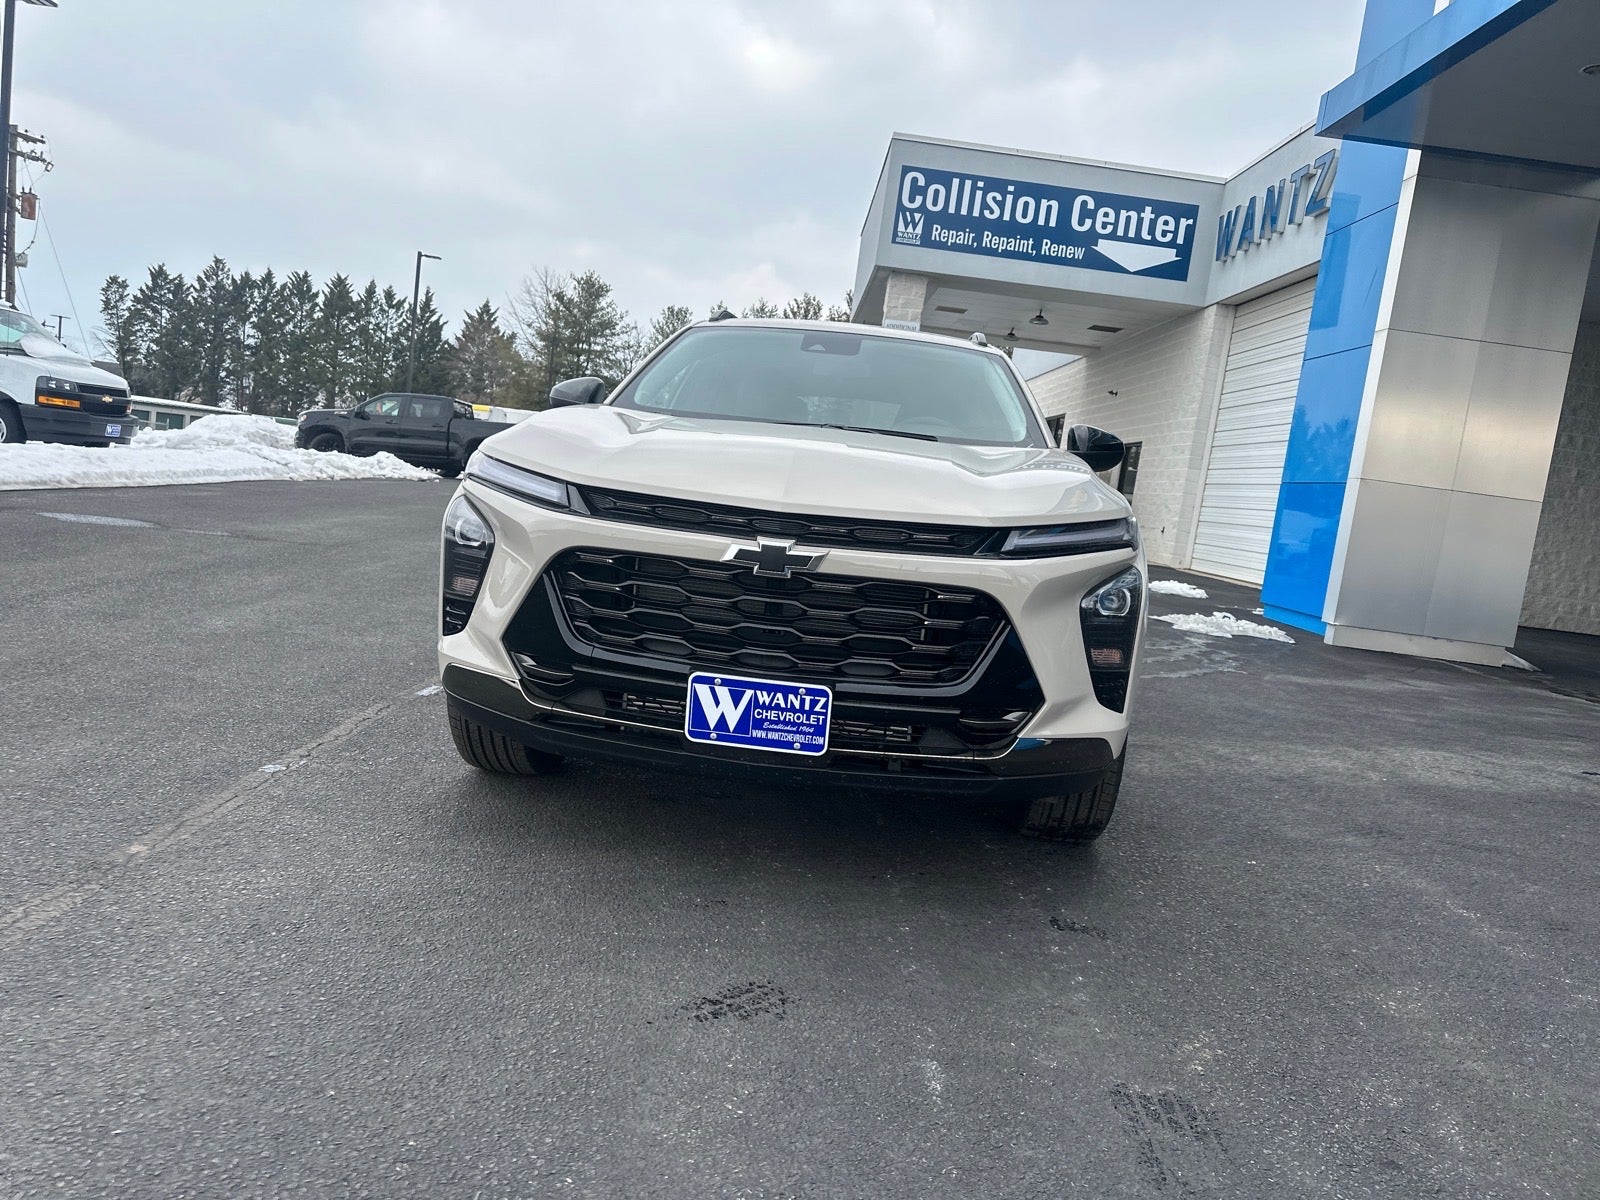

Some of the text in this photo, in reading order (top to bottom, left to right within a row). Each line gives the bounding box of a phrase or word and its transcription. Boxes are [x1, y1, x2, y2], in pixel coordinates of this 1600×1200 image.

[901, 171, 1194, 245] Collision Center
[1216, 149, 1339, 262] WANTZ
[931, 224, 1086, 260] Repair, Repaint, Renew
[694, 684, 754, 733] W
[755, 690, 828, 713] WANTZ
[754, 708, 826, 726] CHEVROLET
[762, 721, 798, 731] Established
[752, 729, 825, 745] WWW.WANTZCHEVROLET.COM
